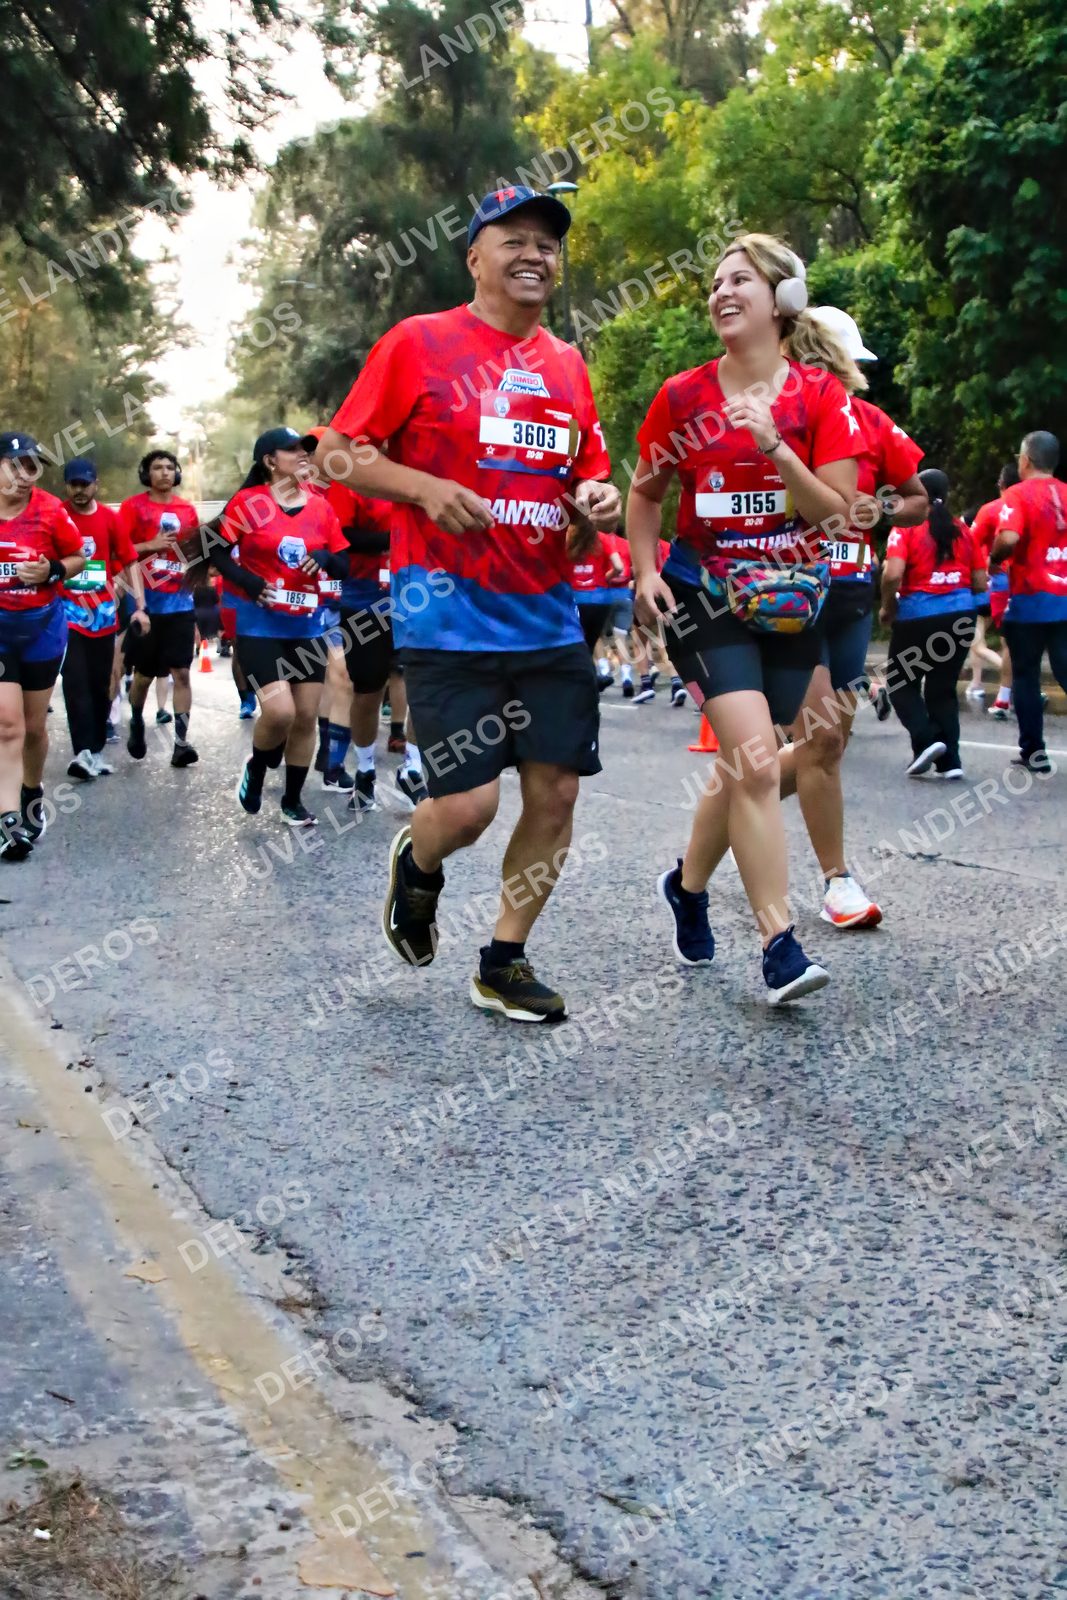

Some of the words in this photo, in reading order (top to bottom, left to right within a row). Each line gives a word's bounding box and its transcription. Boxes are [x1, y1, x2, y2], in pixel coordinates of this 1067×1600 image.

[513, 422, 556, 449] 3603
[731, 492, 776, 514] 3155
[286, 591, 306, 605] 1852
